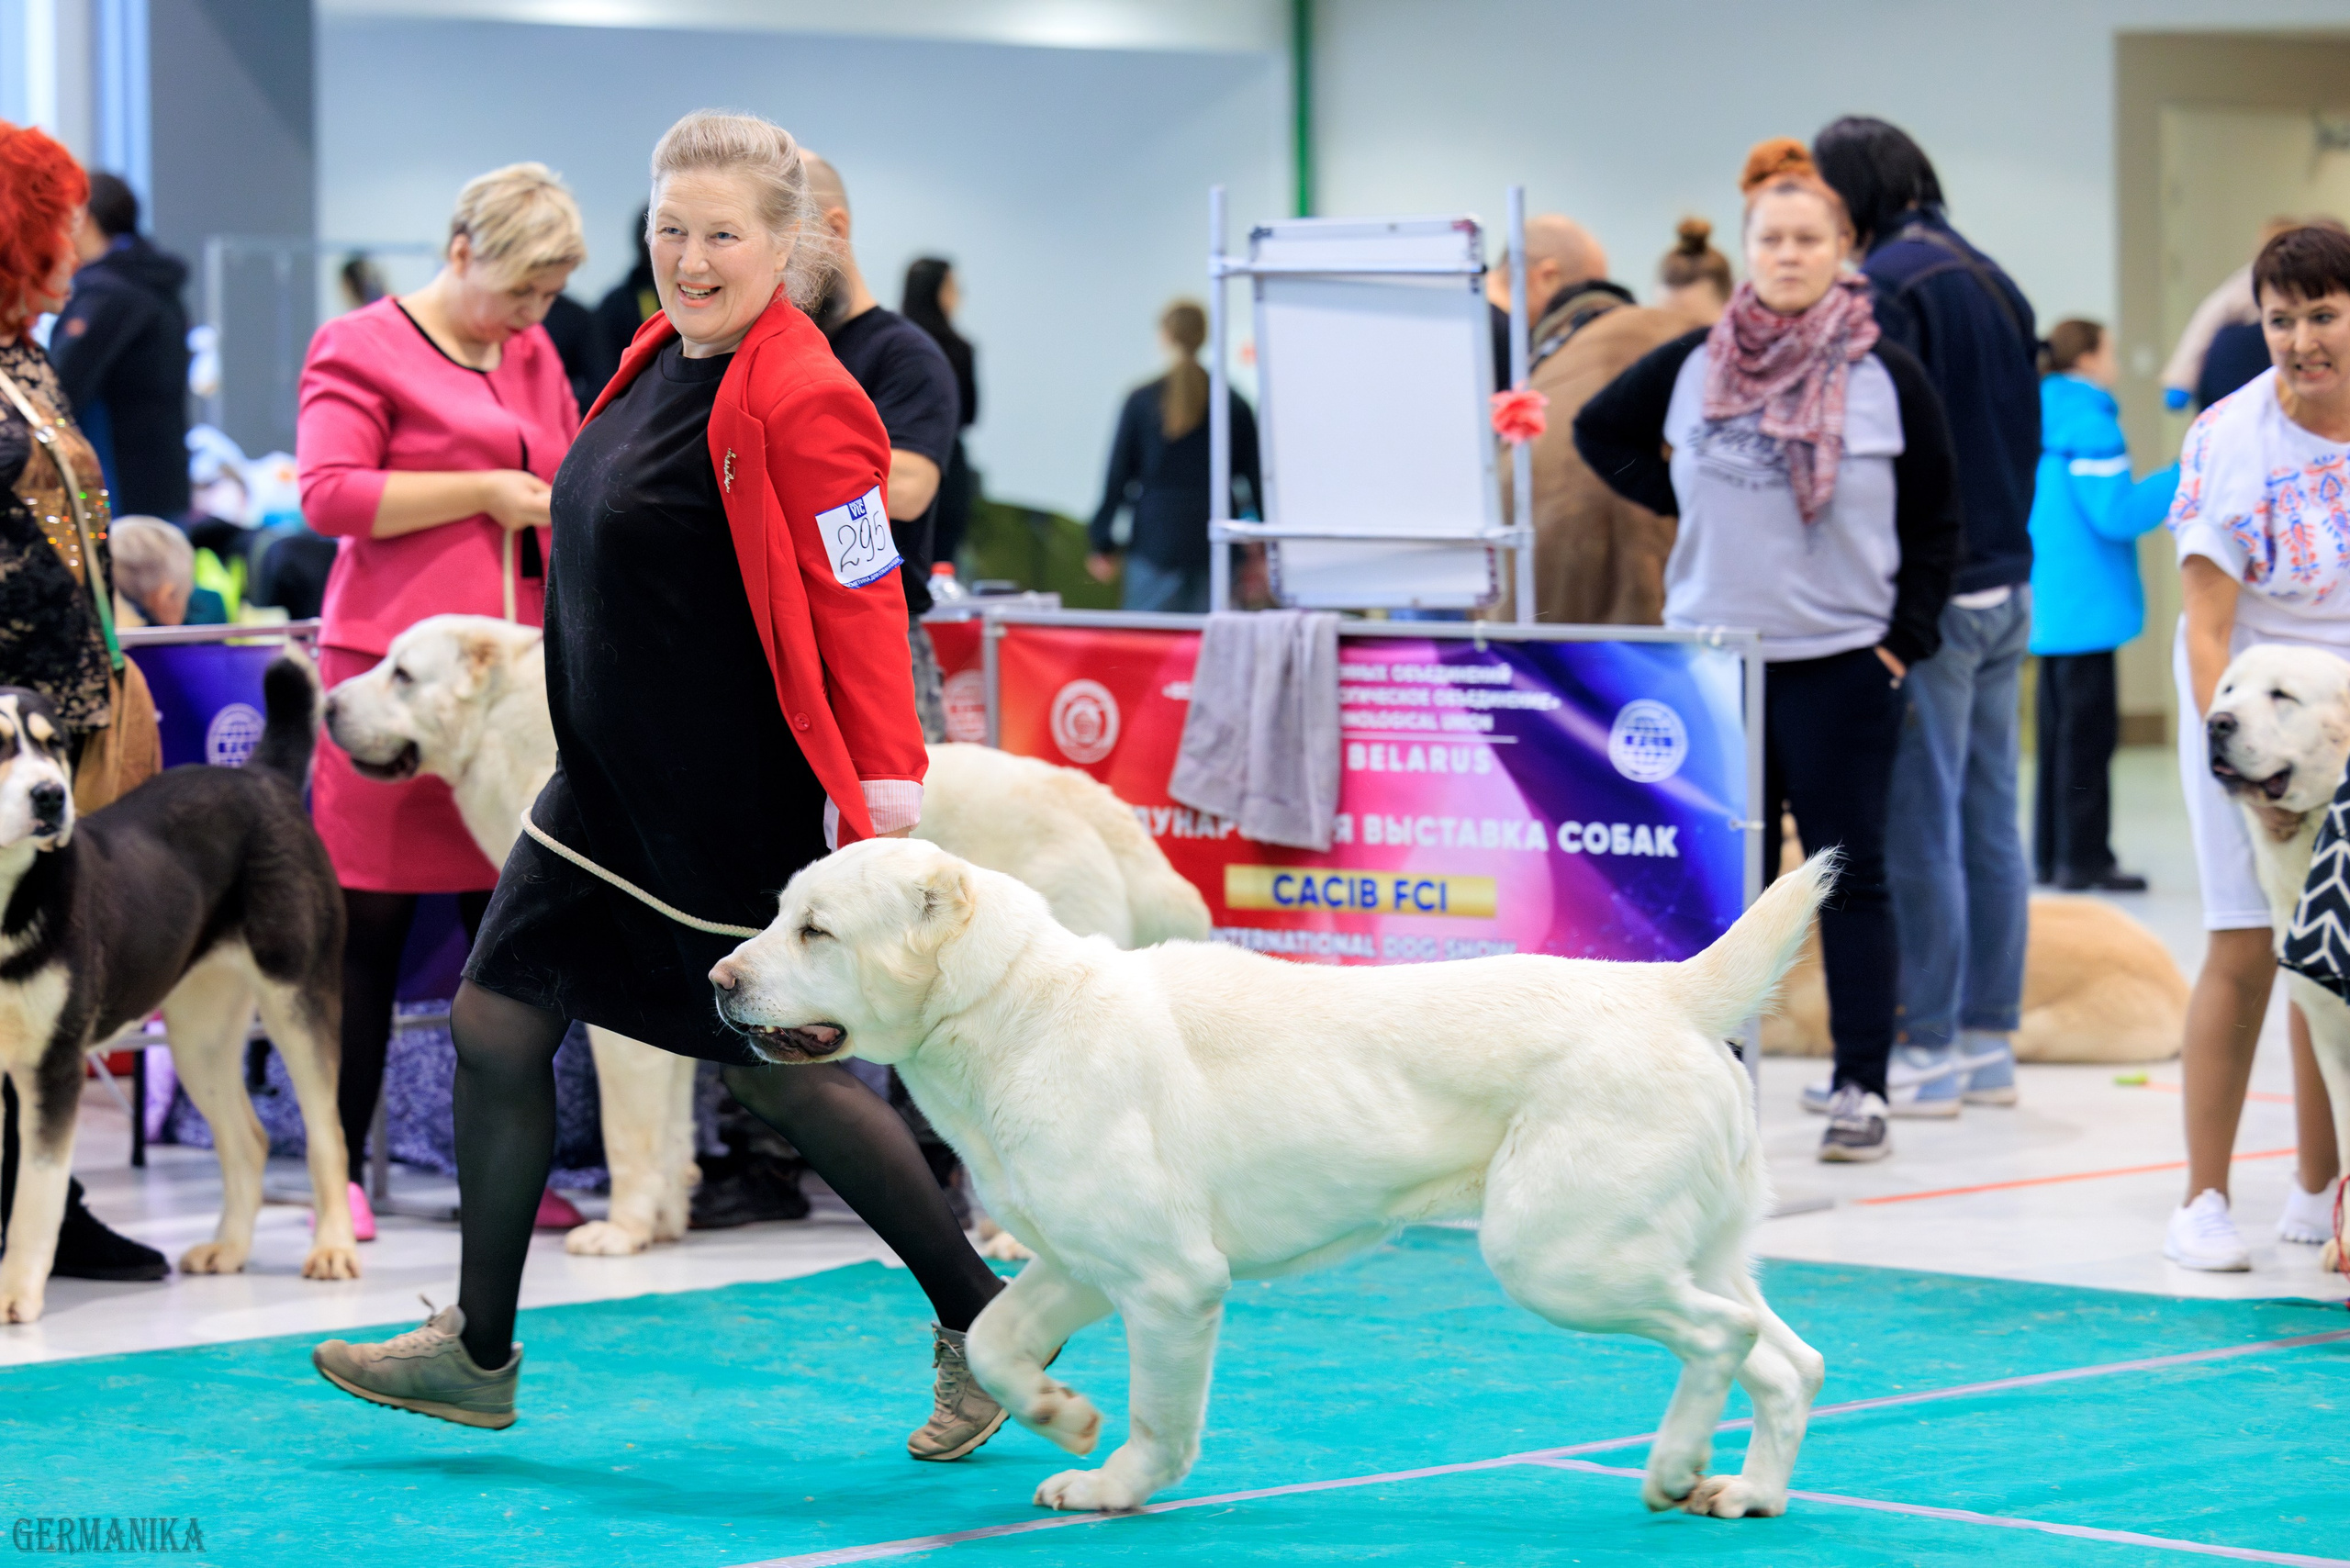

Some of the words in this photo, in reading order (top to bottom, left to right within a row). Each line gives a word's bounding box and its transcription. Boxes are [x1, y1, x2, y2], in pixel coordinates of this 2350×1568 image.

[837, 510, 886, 573] 295
[1347, 743, 1494, 775] BELARUS
[1362, 815, 1550, 852] ВЫСТАВКА
[1556, 820, 1679, 857] СОБАК
[1270, 872, 1380, 912] CACIB
[1393, 878, 1449, 913] FCI
[1383, 935, 1438, 959] DOG
